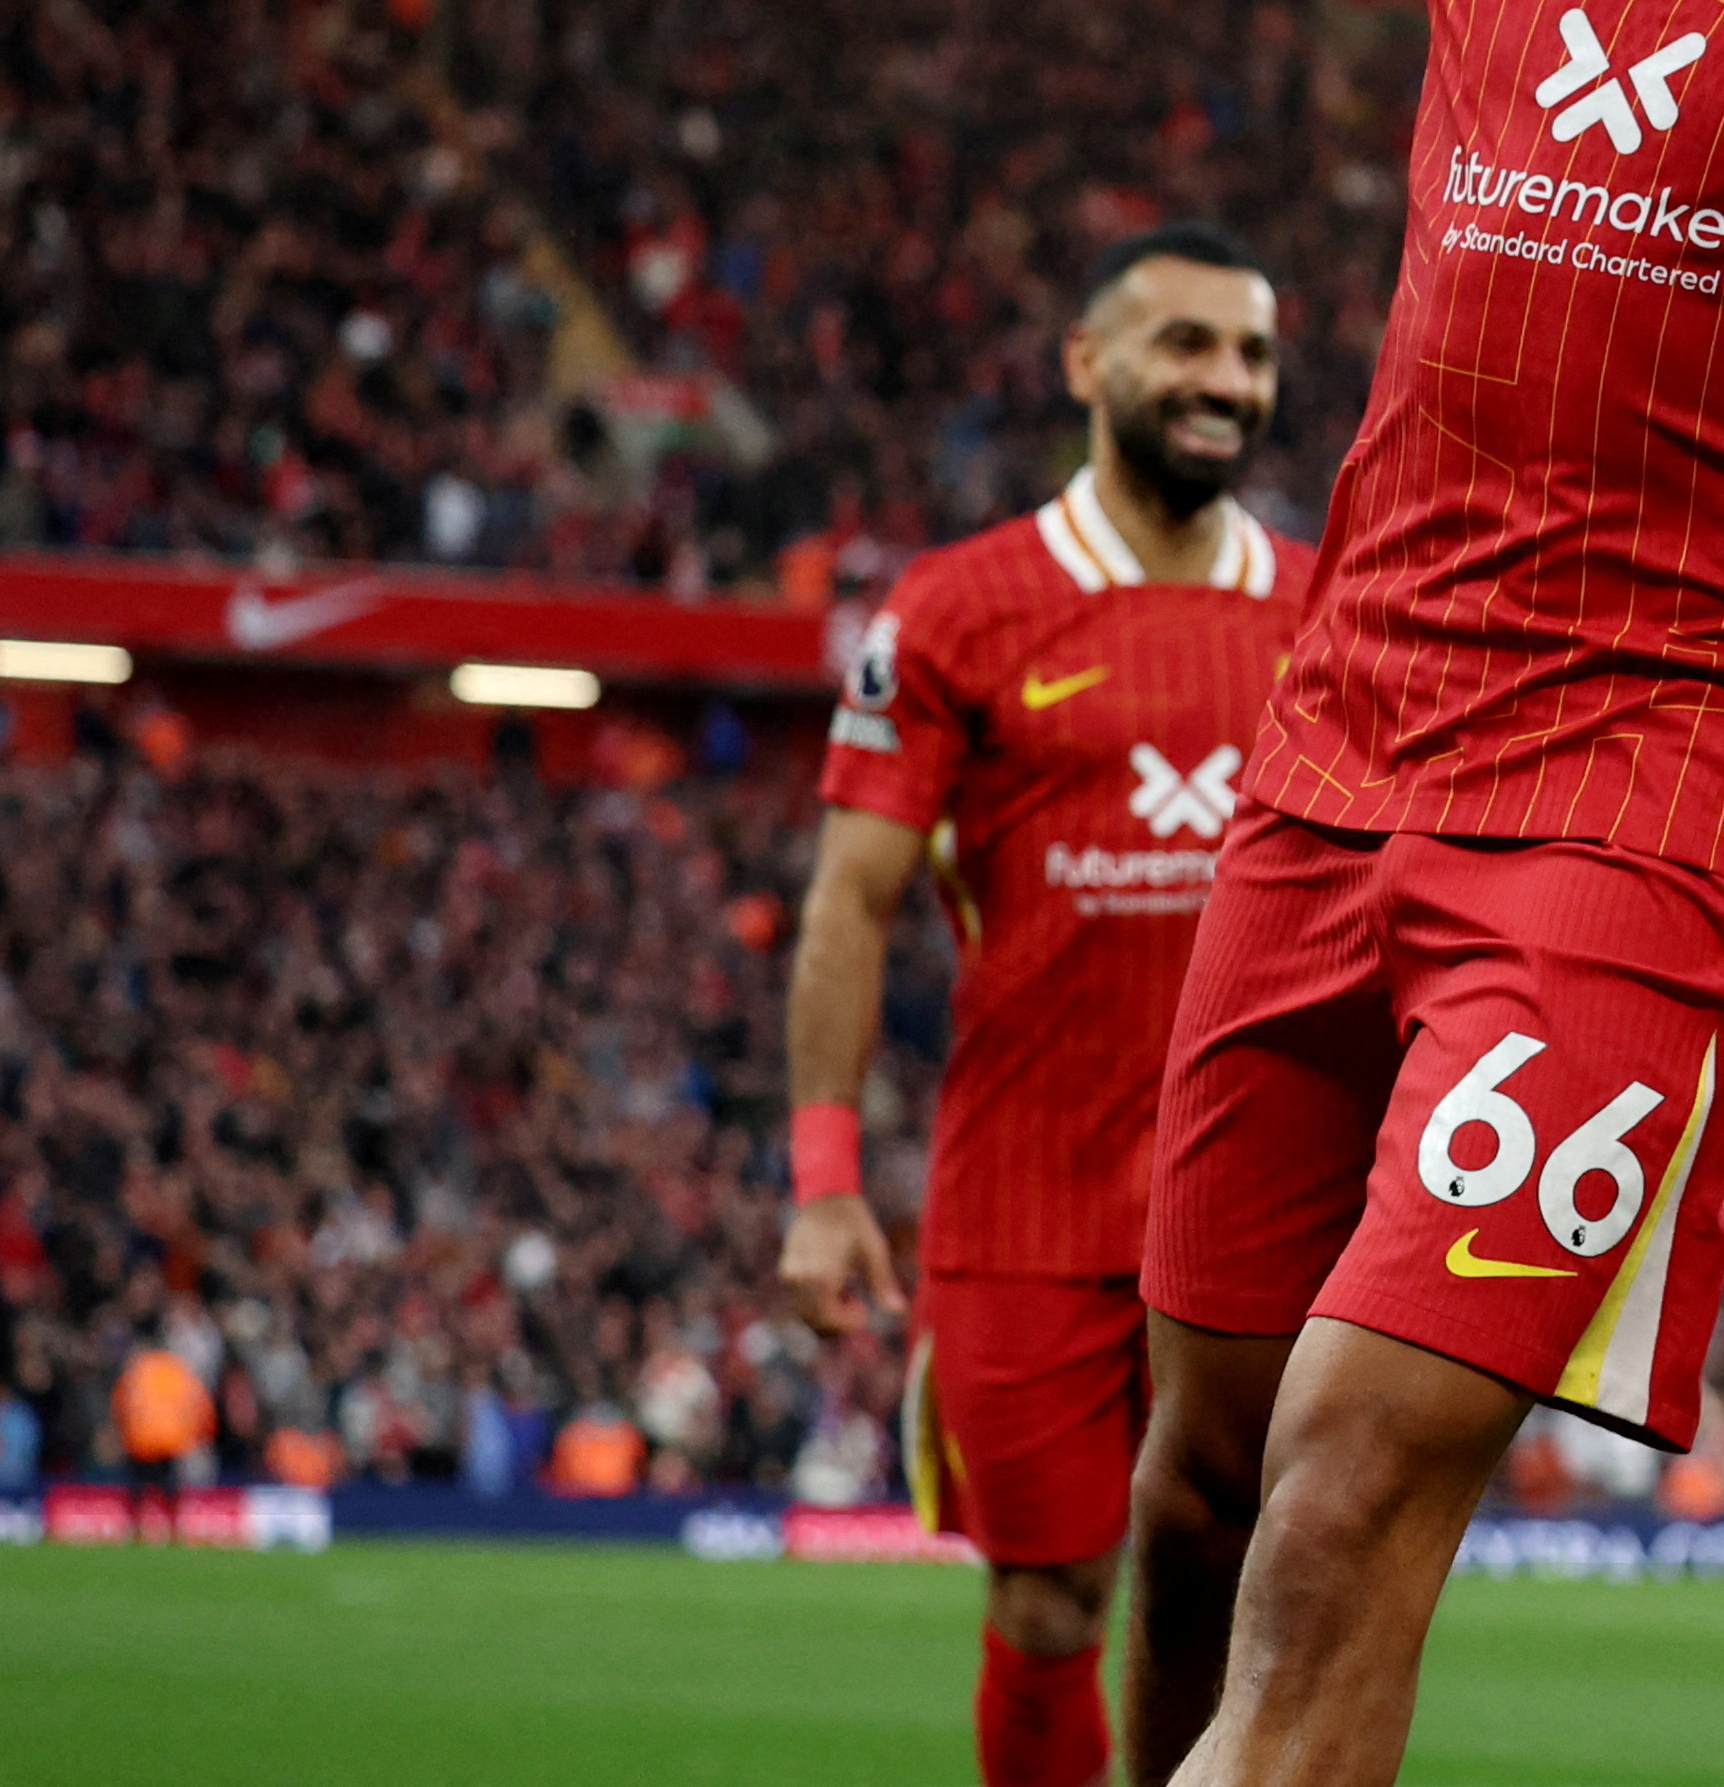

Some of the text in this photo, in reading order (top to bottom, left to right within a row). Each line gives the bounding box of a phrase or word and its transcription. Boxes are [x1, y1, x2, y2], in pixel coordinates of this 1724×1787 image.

[1441, 223, 1722, 294] by Standard Chartered
[1417, 1030, 1667, 1257] 66
